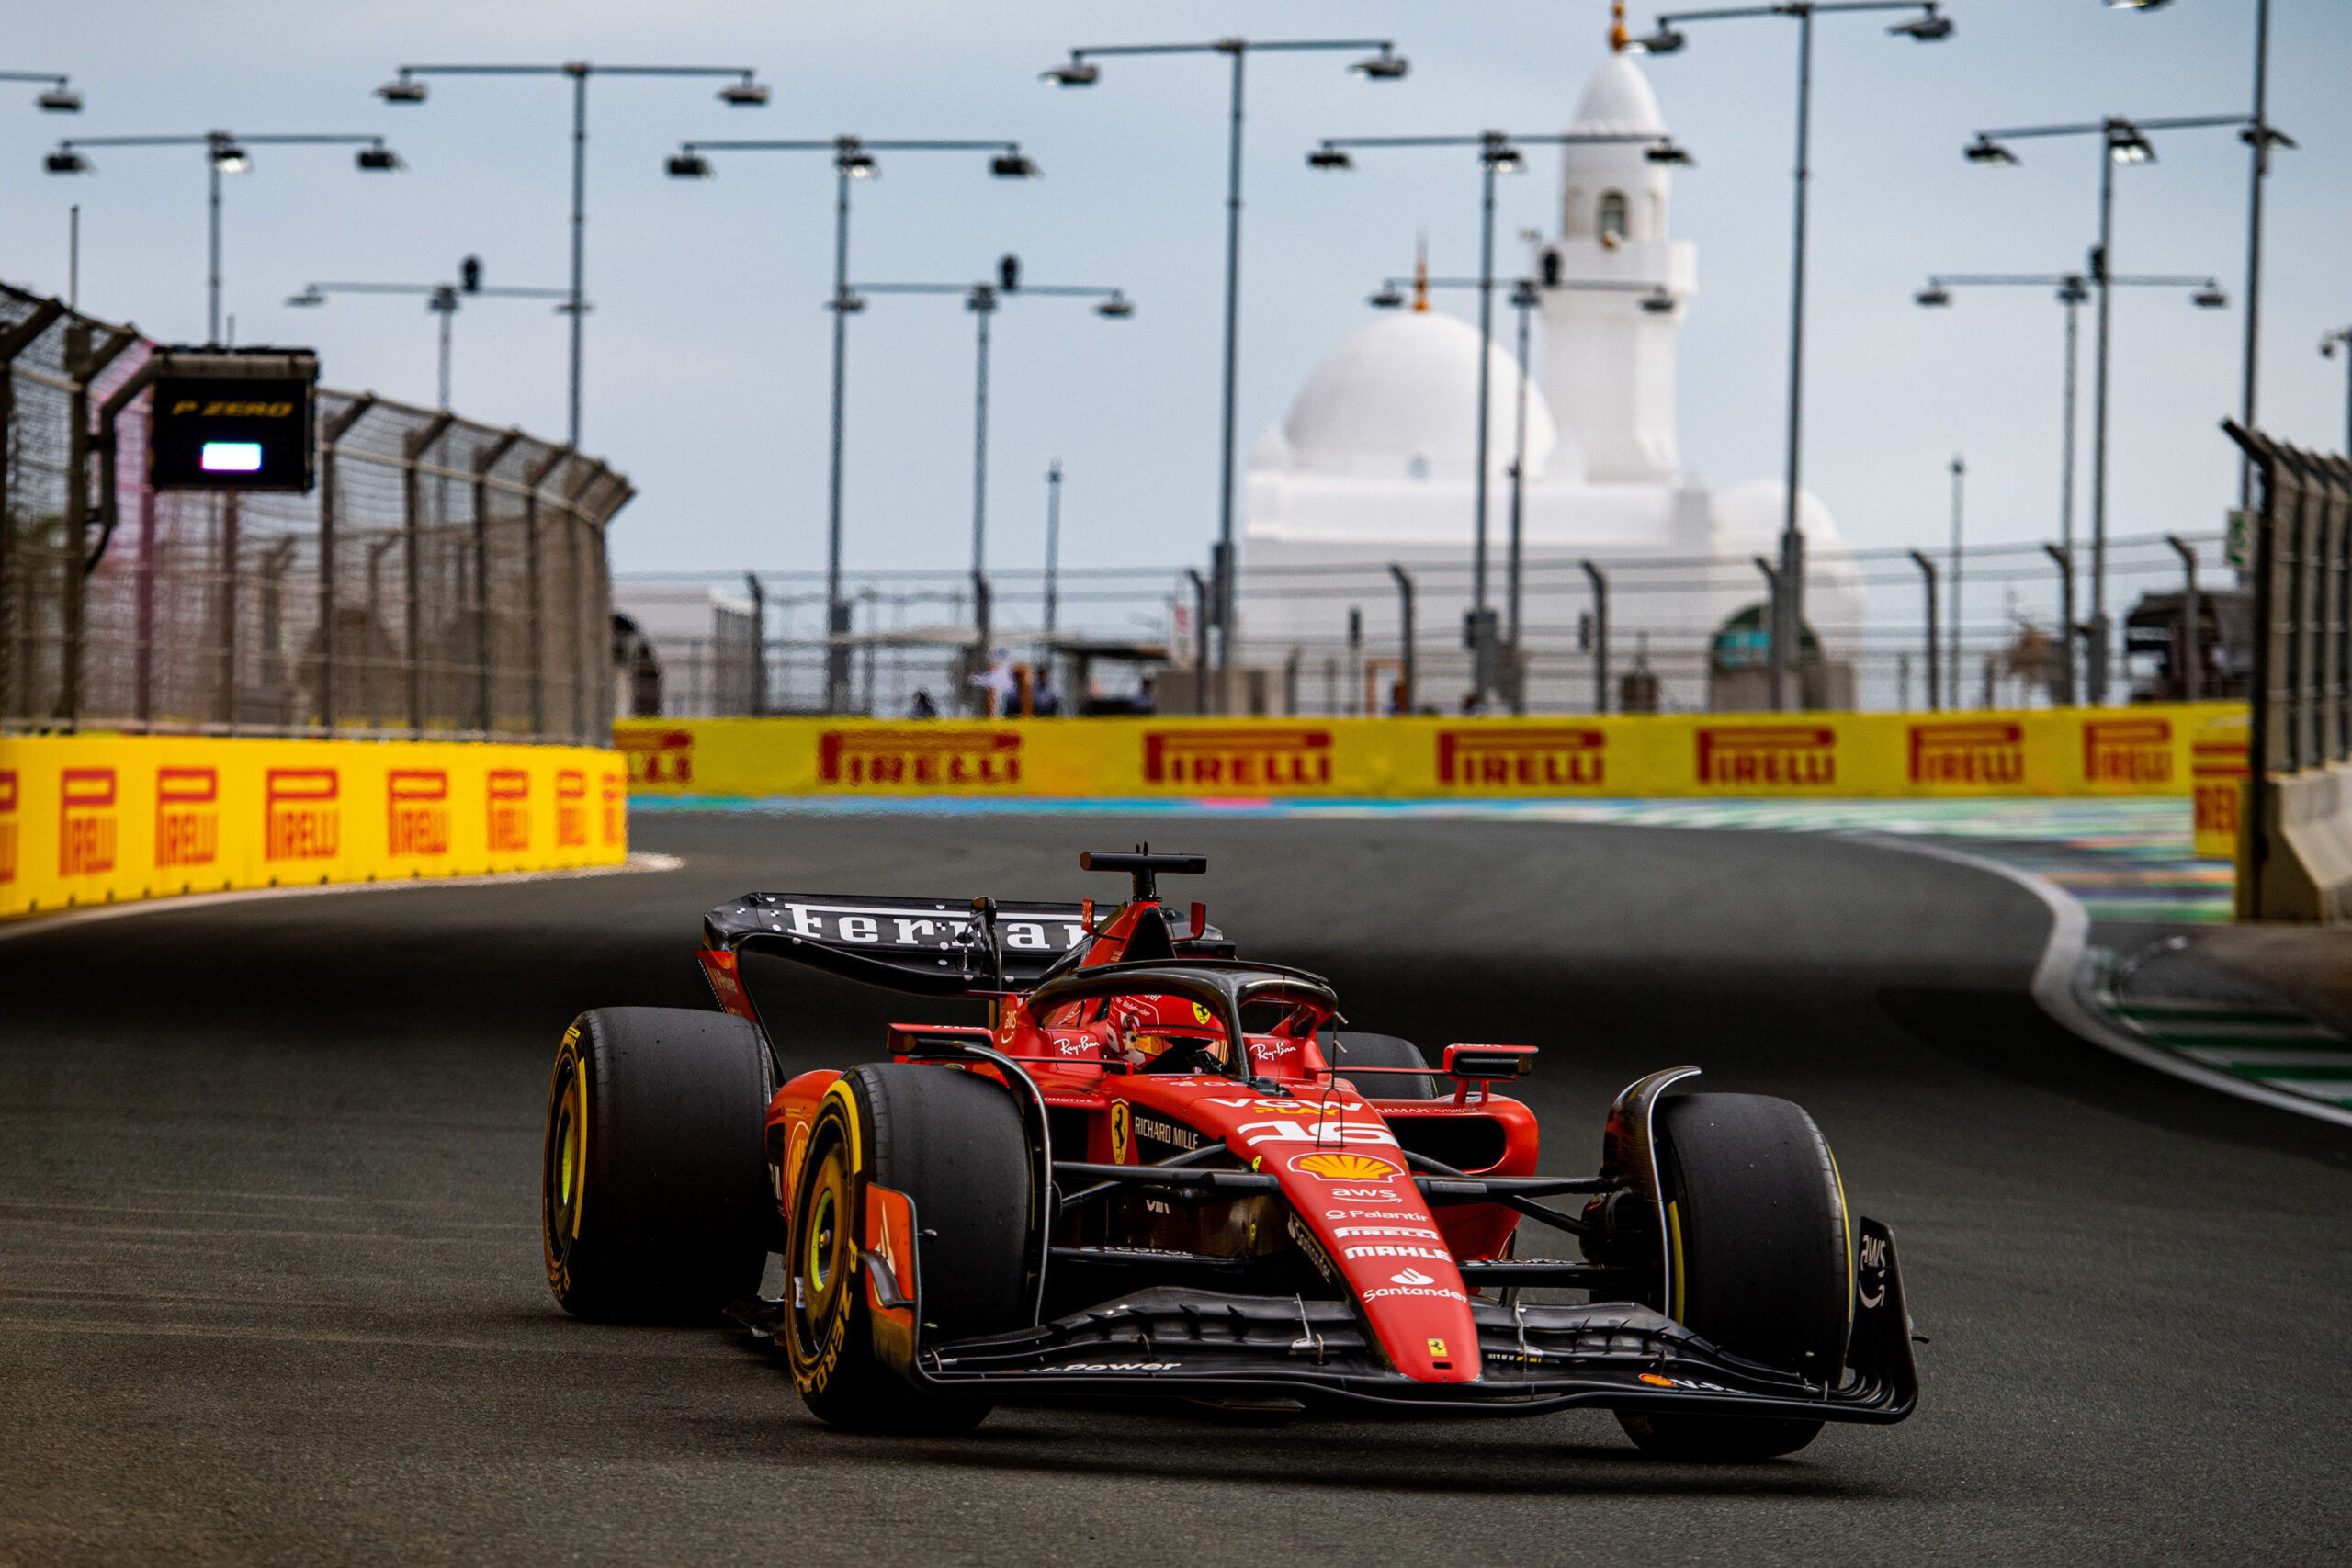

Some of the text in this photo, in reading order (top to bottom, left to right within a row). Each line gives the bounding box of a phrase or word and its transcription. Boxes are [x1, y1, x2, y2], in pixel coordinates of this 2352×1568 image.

[172, 400, 293, 417] P ZERO
[1144, 730, 1332, 785] PIRELLI
[1436, 729, 1605, 785] PIRELLI
[1696, 726, 1836, 785] PIRELLI
[1908, 721, 2025, 784] PIRELLI
[266, 768, 339, 862] PIRELLI
[1205, 1098, 1363, 1112] VGW
[1253, 1106, 1339, 1116] PLAY
[1135, 1116, 1199, 1150] RICHARD MILLE
[1238, 1121, 1401, 1149] 16
[1350, 1210, 1429, 1222] Palantir
[1334, 1226, 1440, 1240] PIRELLI
[1344, 1246, 1453, 1263] MAHLE
[1363, 1286, 1469, 1303] Santander
[817, 1237, 858, 1394] P ZERO
